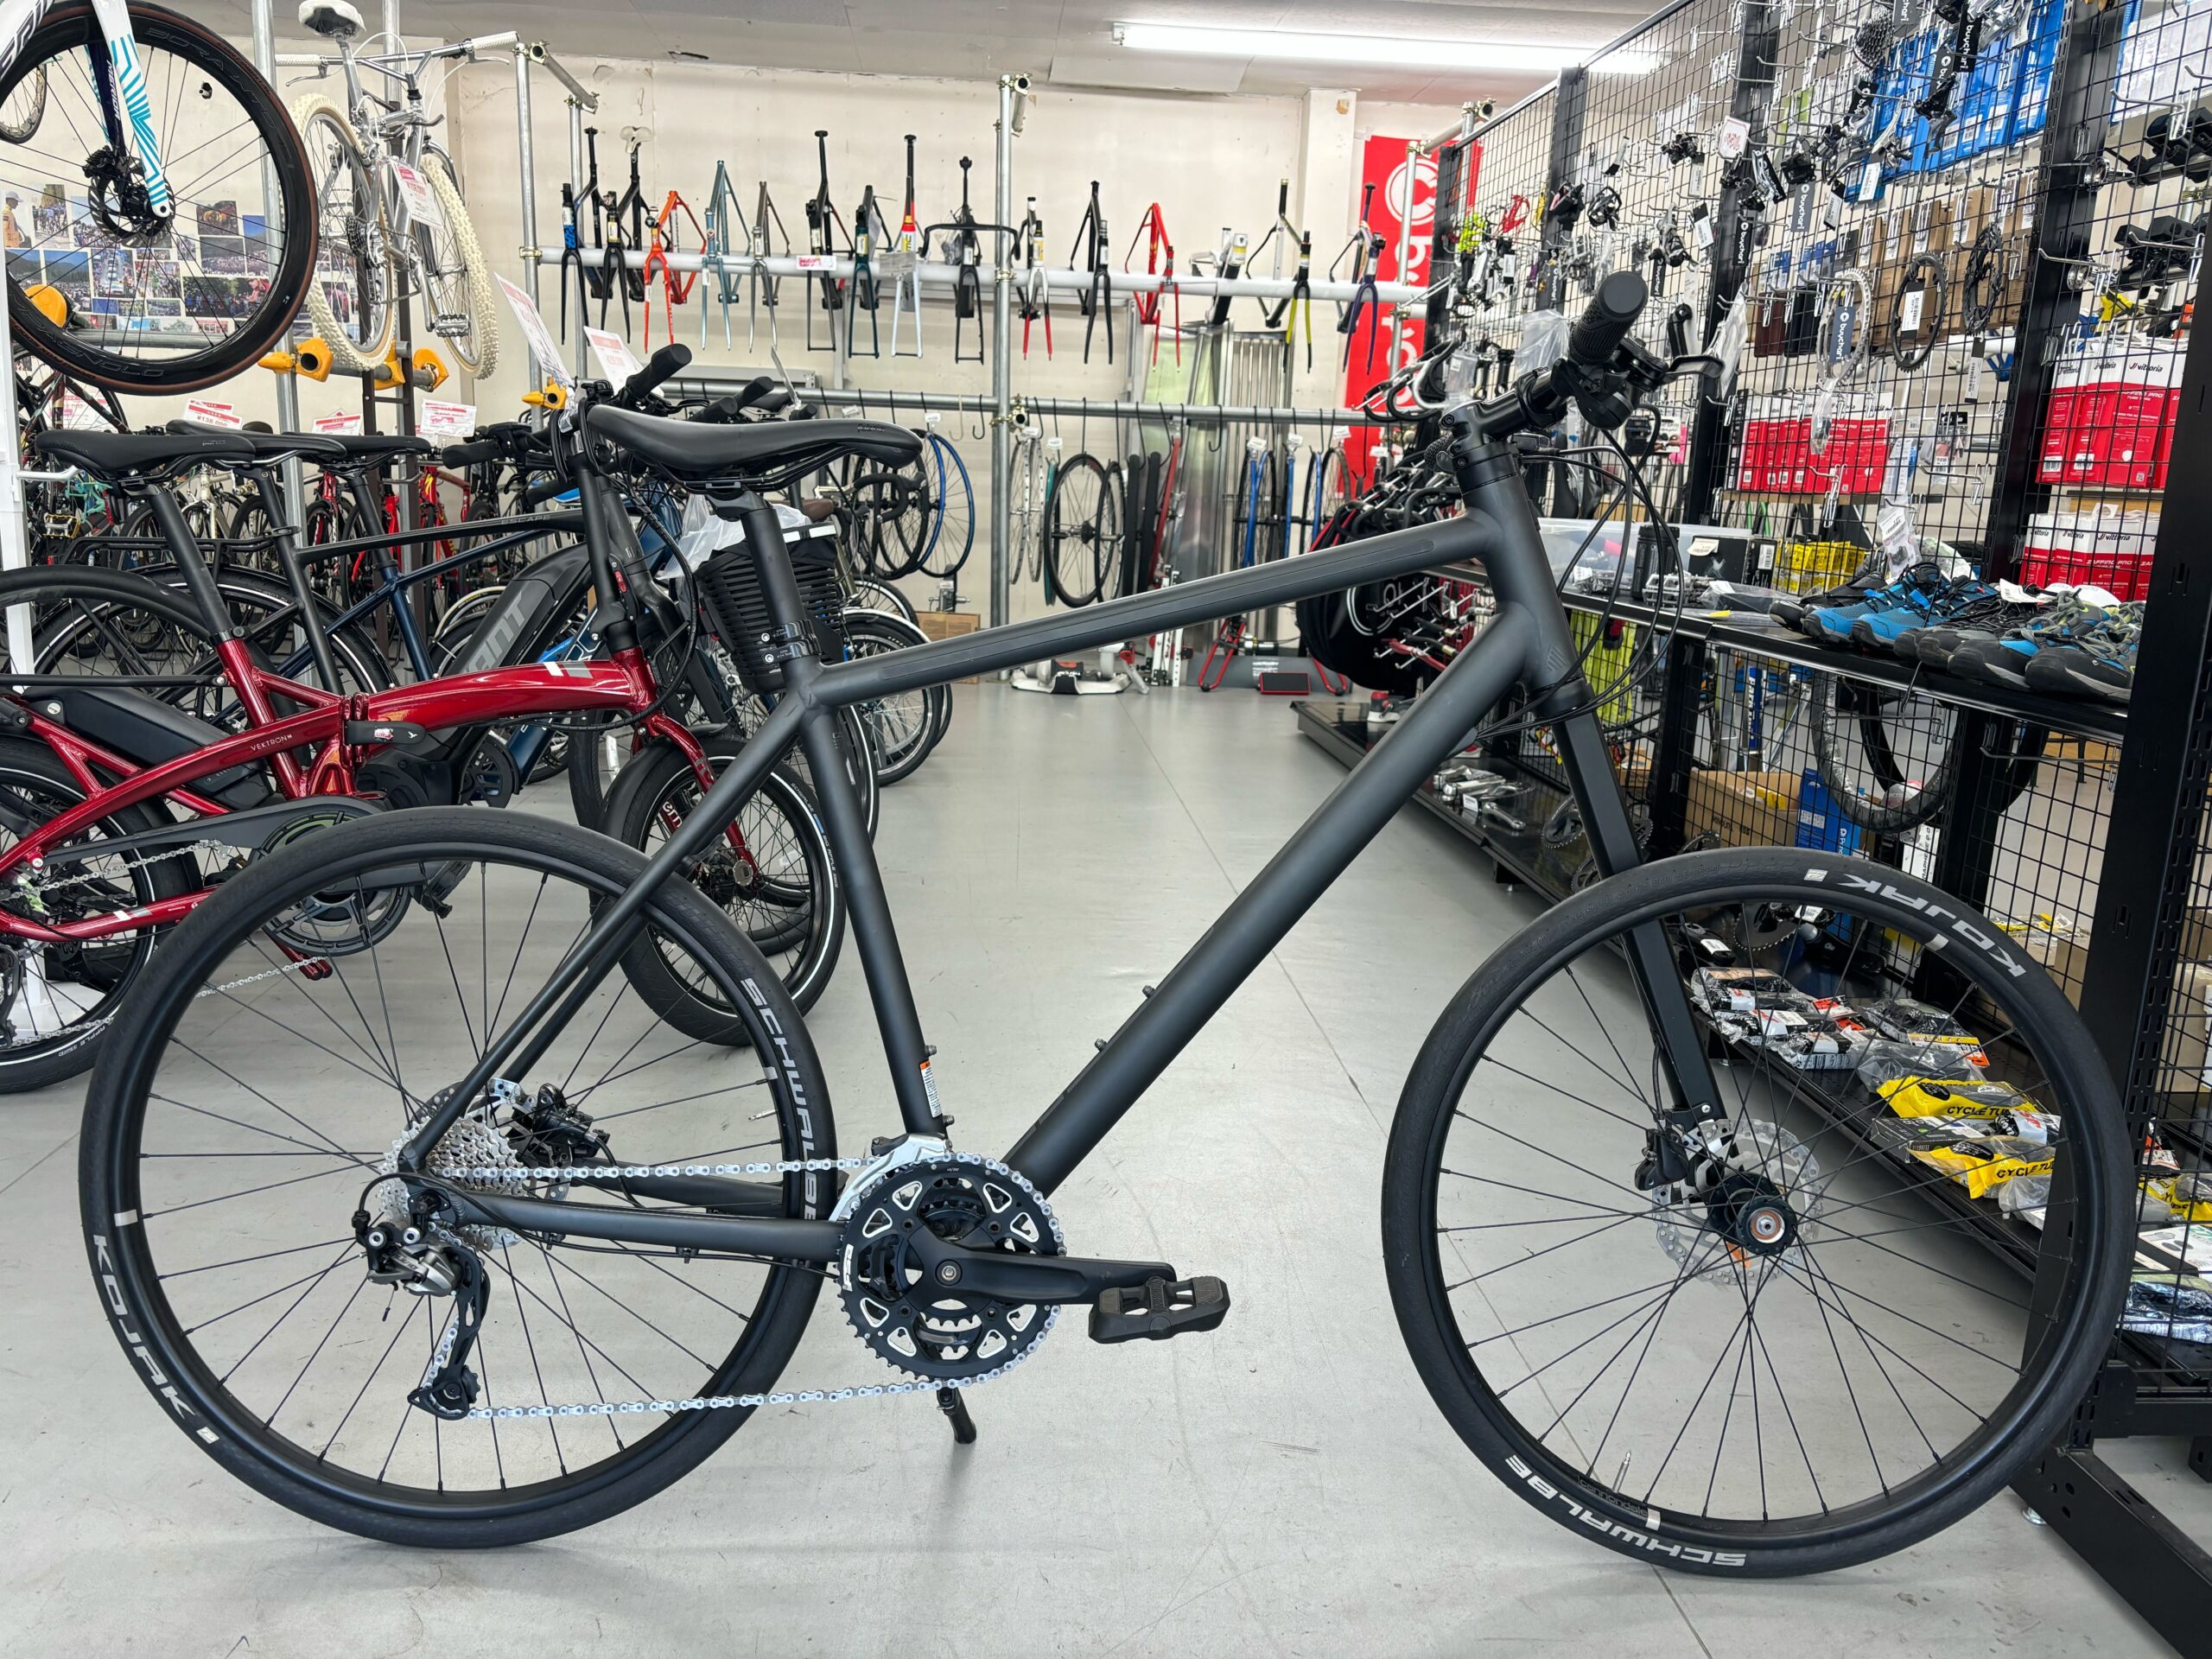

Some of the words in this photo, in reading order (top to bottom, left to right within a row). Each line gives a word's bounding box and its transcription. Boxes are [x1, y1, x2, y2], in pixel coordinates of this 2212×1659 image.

[106, 60, 121, 121] MERIDA
[1796, 194, 1808, 230] buychari
[1738, 232, 1748, 264] buychari
[1835, 324, 1847, 360] buychari
[251, 735, 287, 751] VEKTRON
[1837, 873, 2027, 977] KOJAK
[740, 977, 817, 1220] SCHWALBE
[1947, 1106, 1986, 1116] CYCLE
[1997, 1166, 2037, 1178] CYCLE
[93, 1234, 196, 1421] KOJAK
[1505, 1454, 1746, 1567] SCHWALBE
[1580, 1477, 1647, 1517] cannondale
